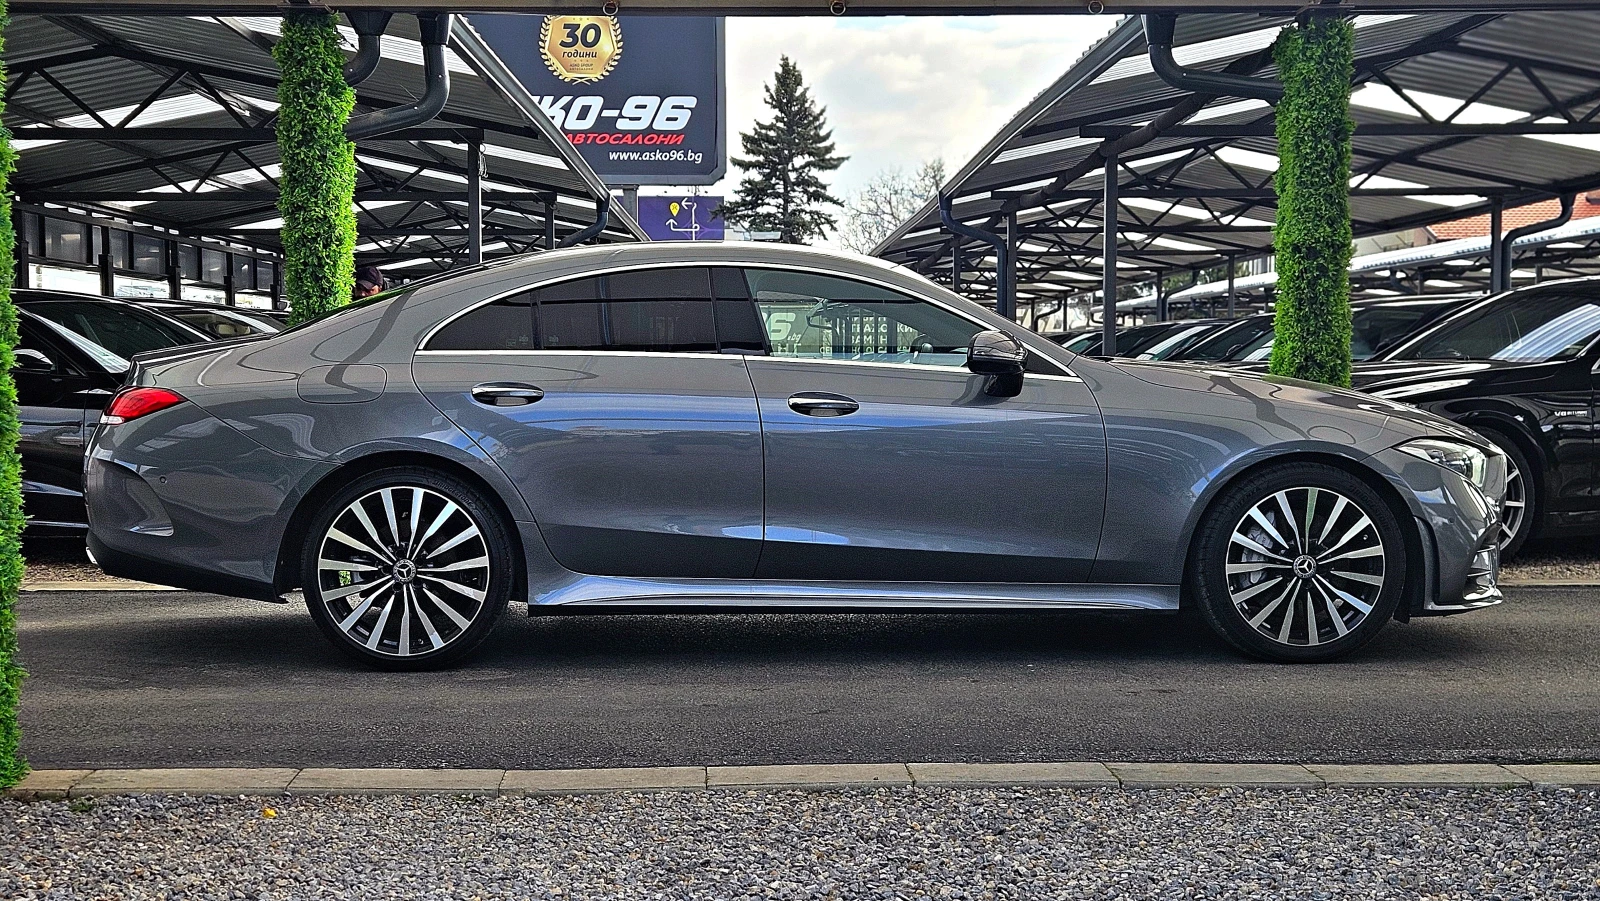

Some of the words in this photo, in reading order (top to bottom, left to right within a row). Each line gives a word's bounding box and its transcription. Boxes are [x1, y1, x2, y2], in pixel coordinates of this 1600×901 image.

[559, 23, 602, 48] 30
[562, 49, 598, 58] години
[608, 149, 703, 165] www.asko96.bg
